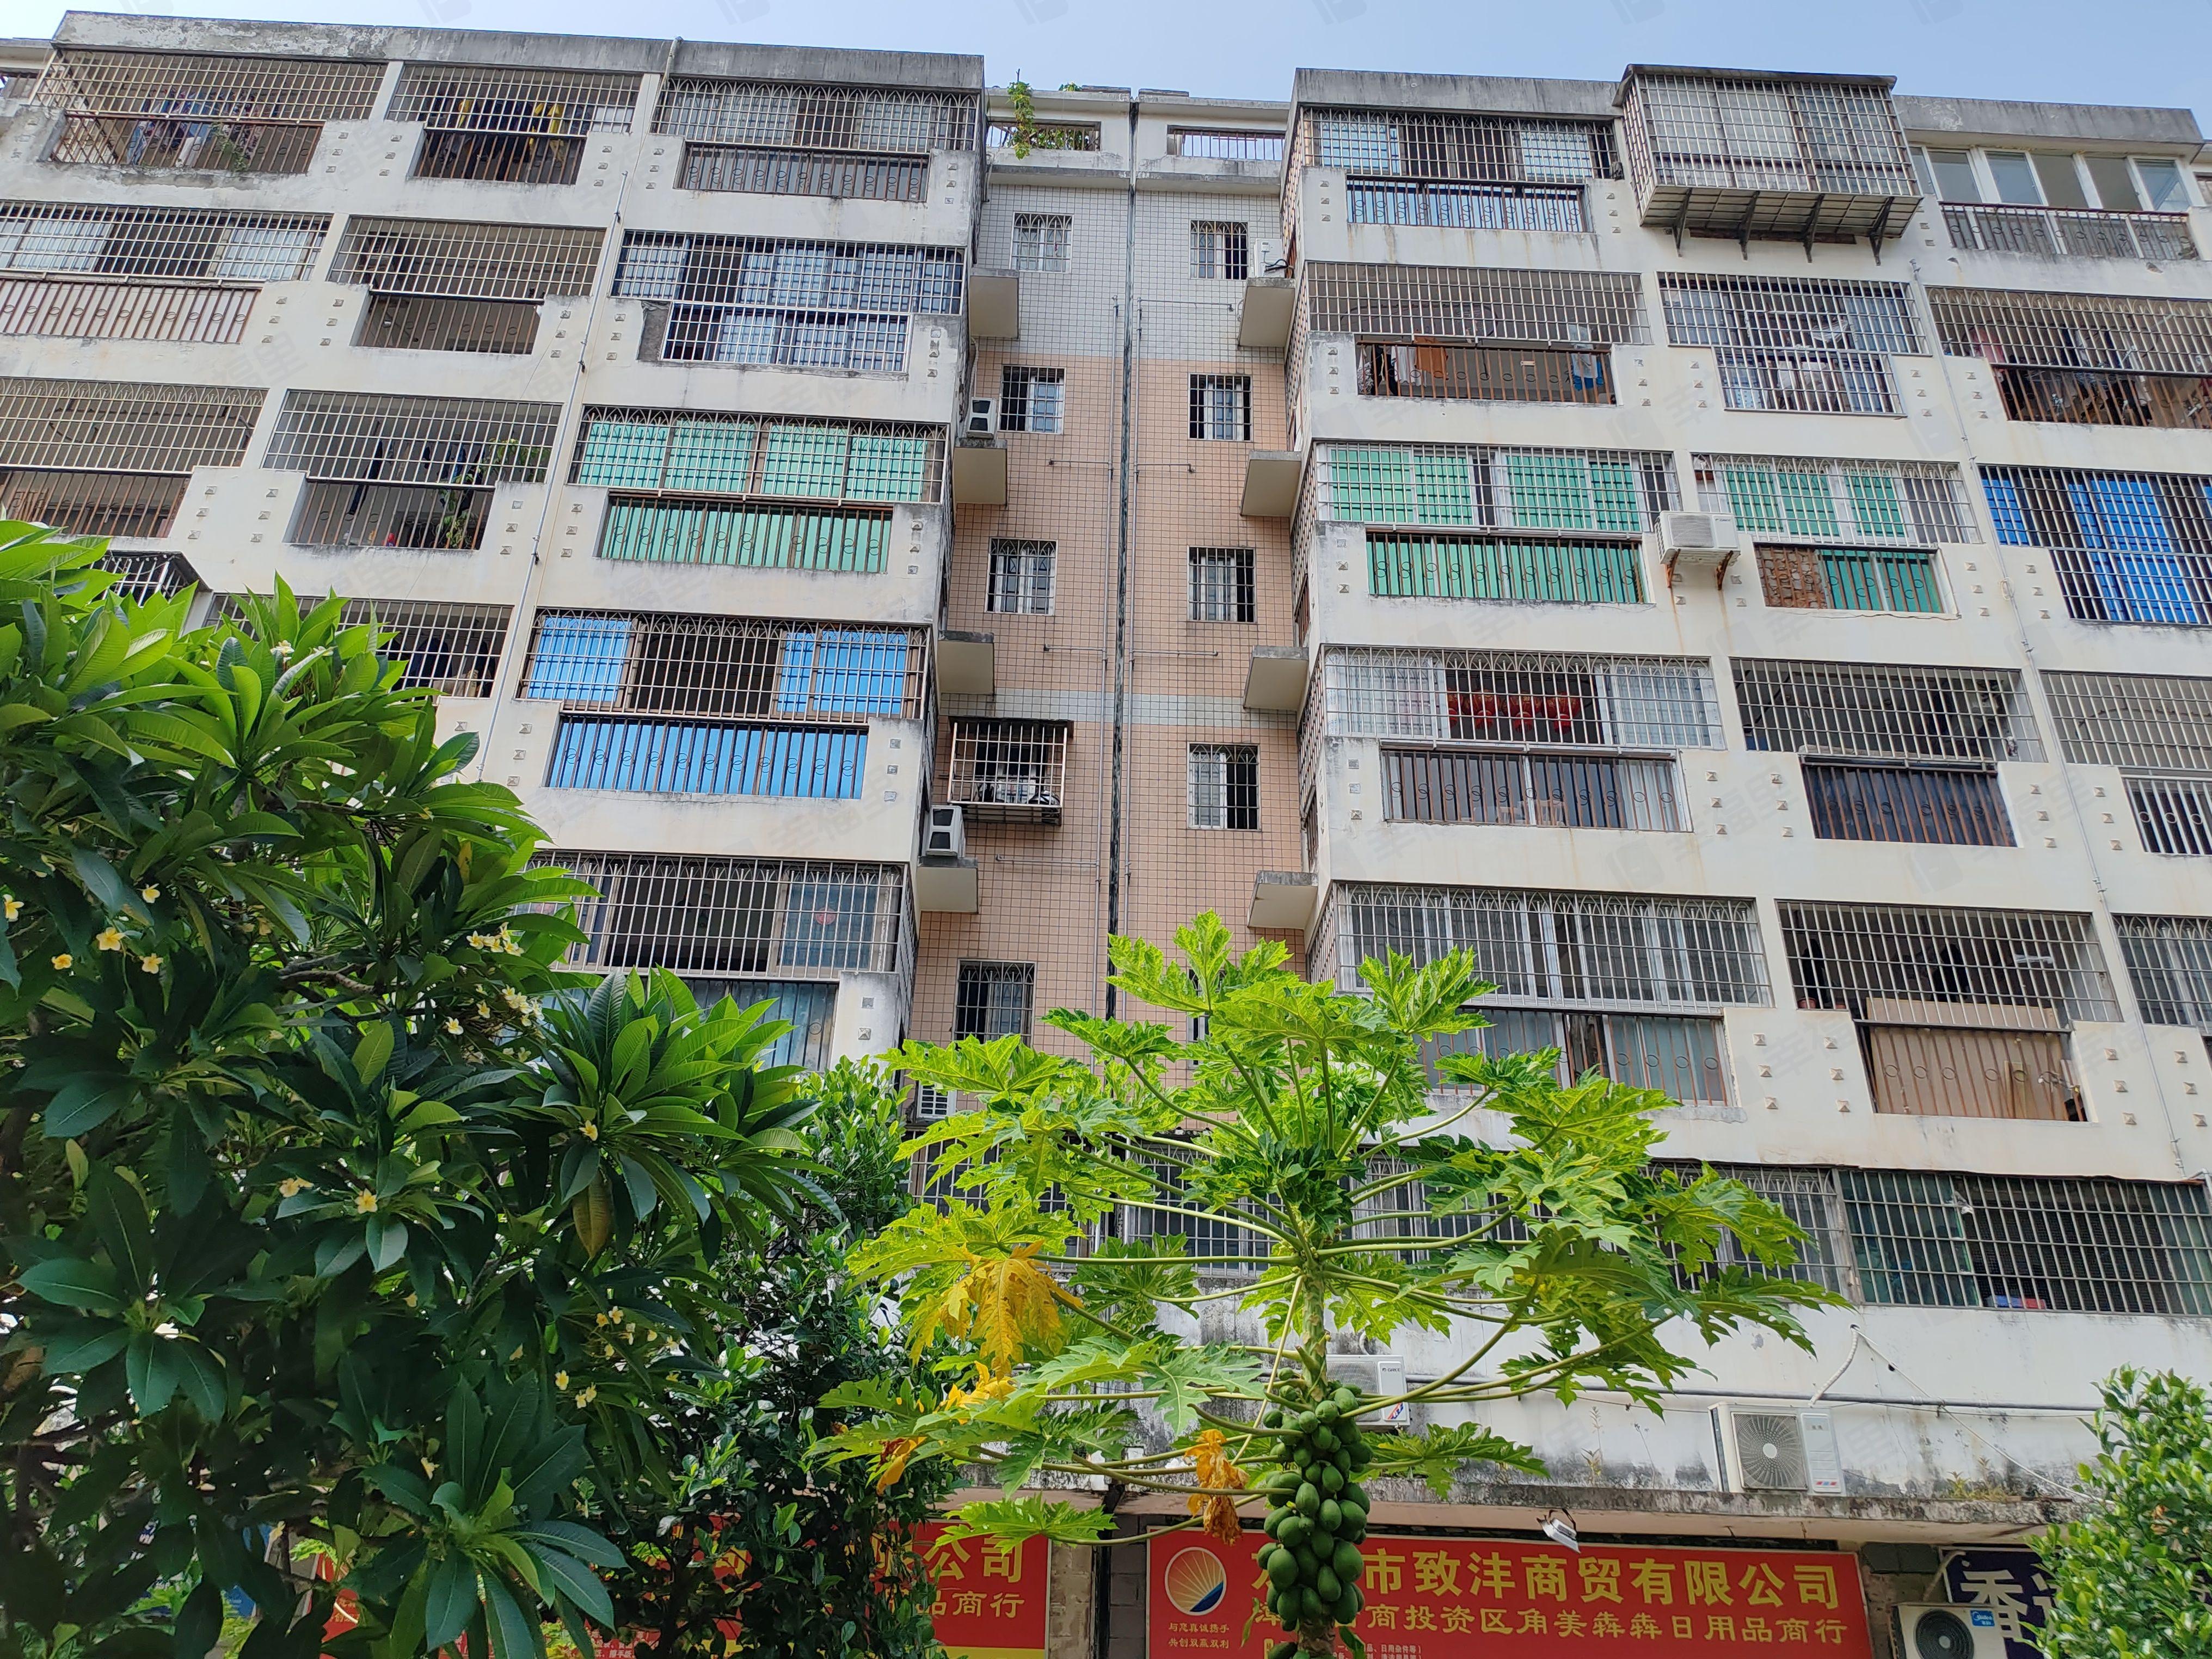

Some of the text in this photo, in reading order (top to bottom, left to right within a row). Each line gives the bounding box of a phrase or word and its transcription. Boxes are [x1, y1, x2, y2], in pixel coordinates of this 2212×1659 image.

[1251, 1547, 1839, 1609] 市致沣商贸有限公司
[1255, 1602, 1848, 1644] 商投资区角美犇犇日用品商行
